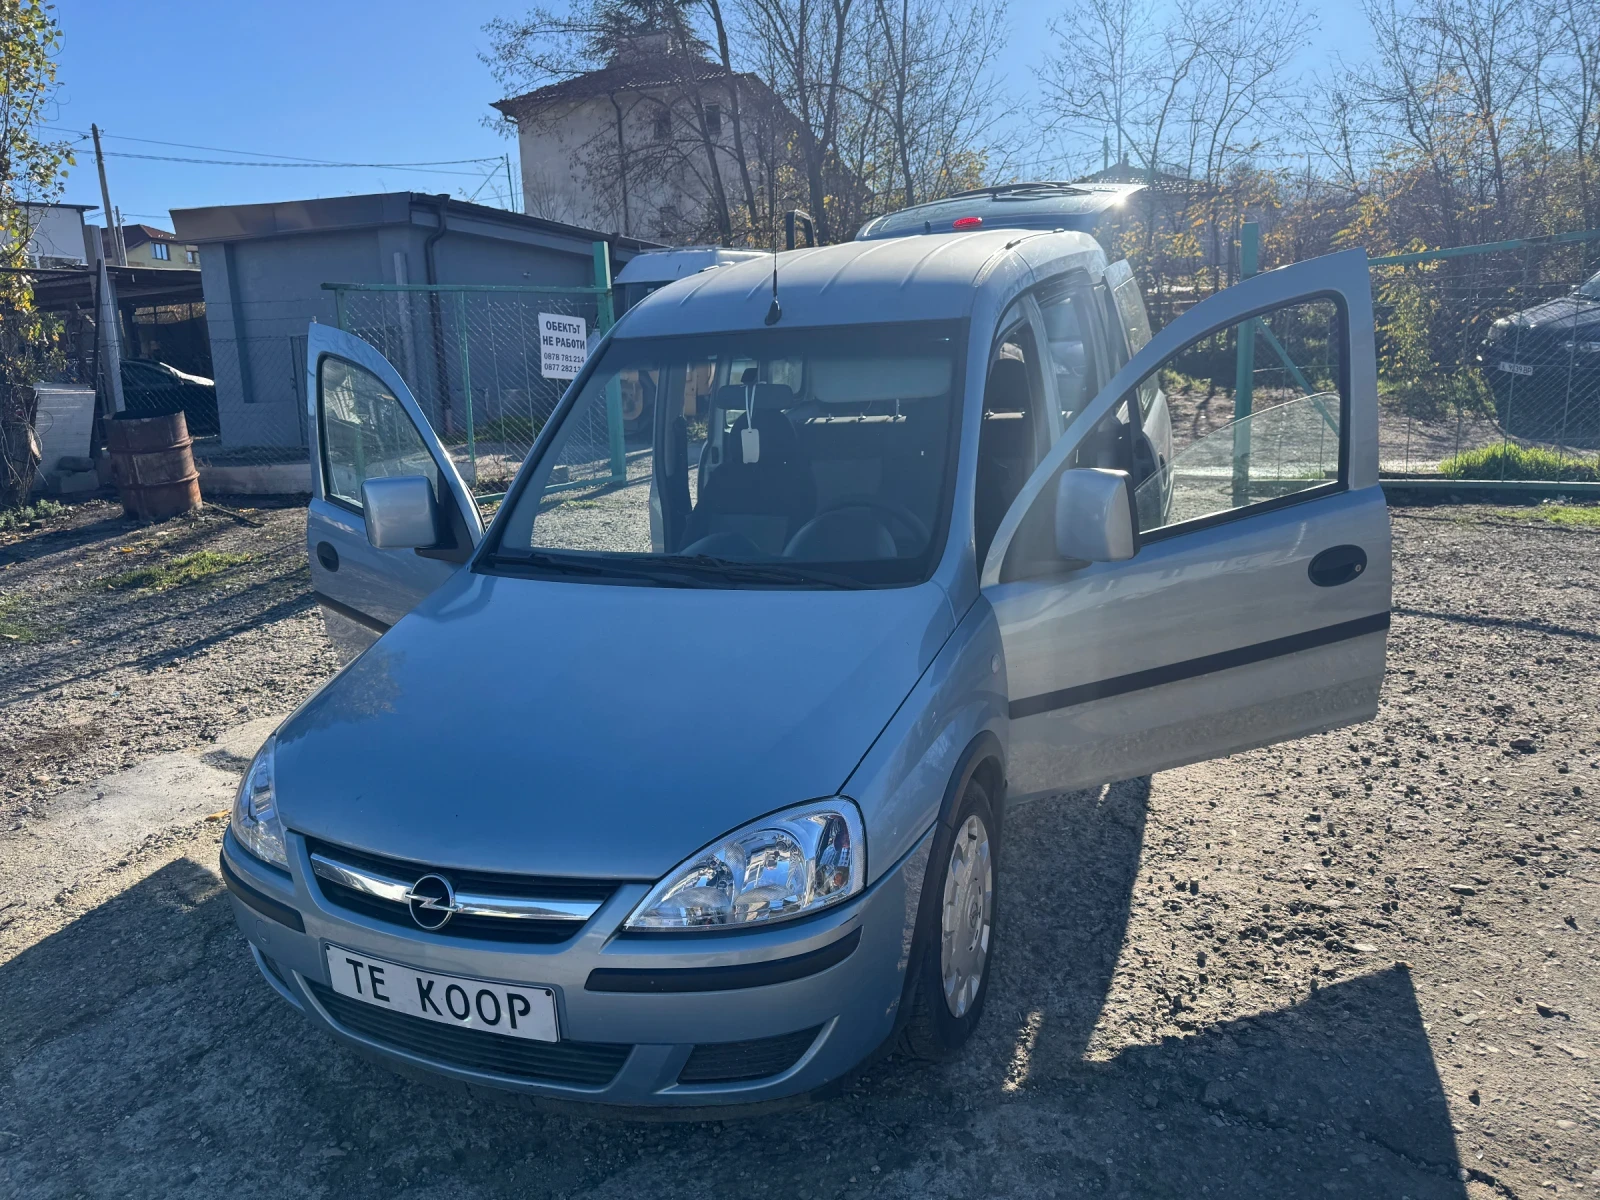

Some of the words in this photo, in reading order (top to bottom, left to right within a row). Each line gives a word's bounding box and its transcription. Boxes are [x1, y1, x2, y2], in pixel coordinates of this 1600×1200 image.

[542, 335, 554, 346] НЕ
[555, 336, 586, 350] РАБОТИ
[345, 957, 391, 1003] TE
[416, 977, 531, 1030] KOOP
